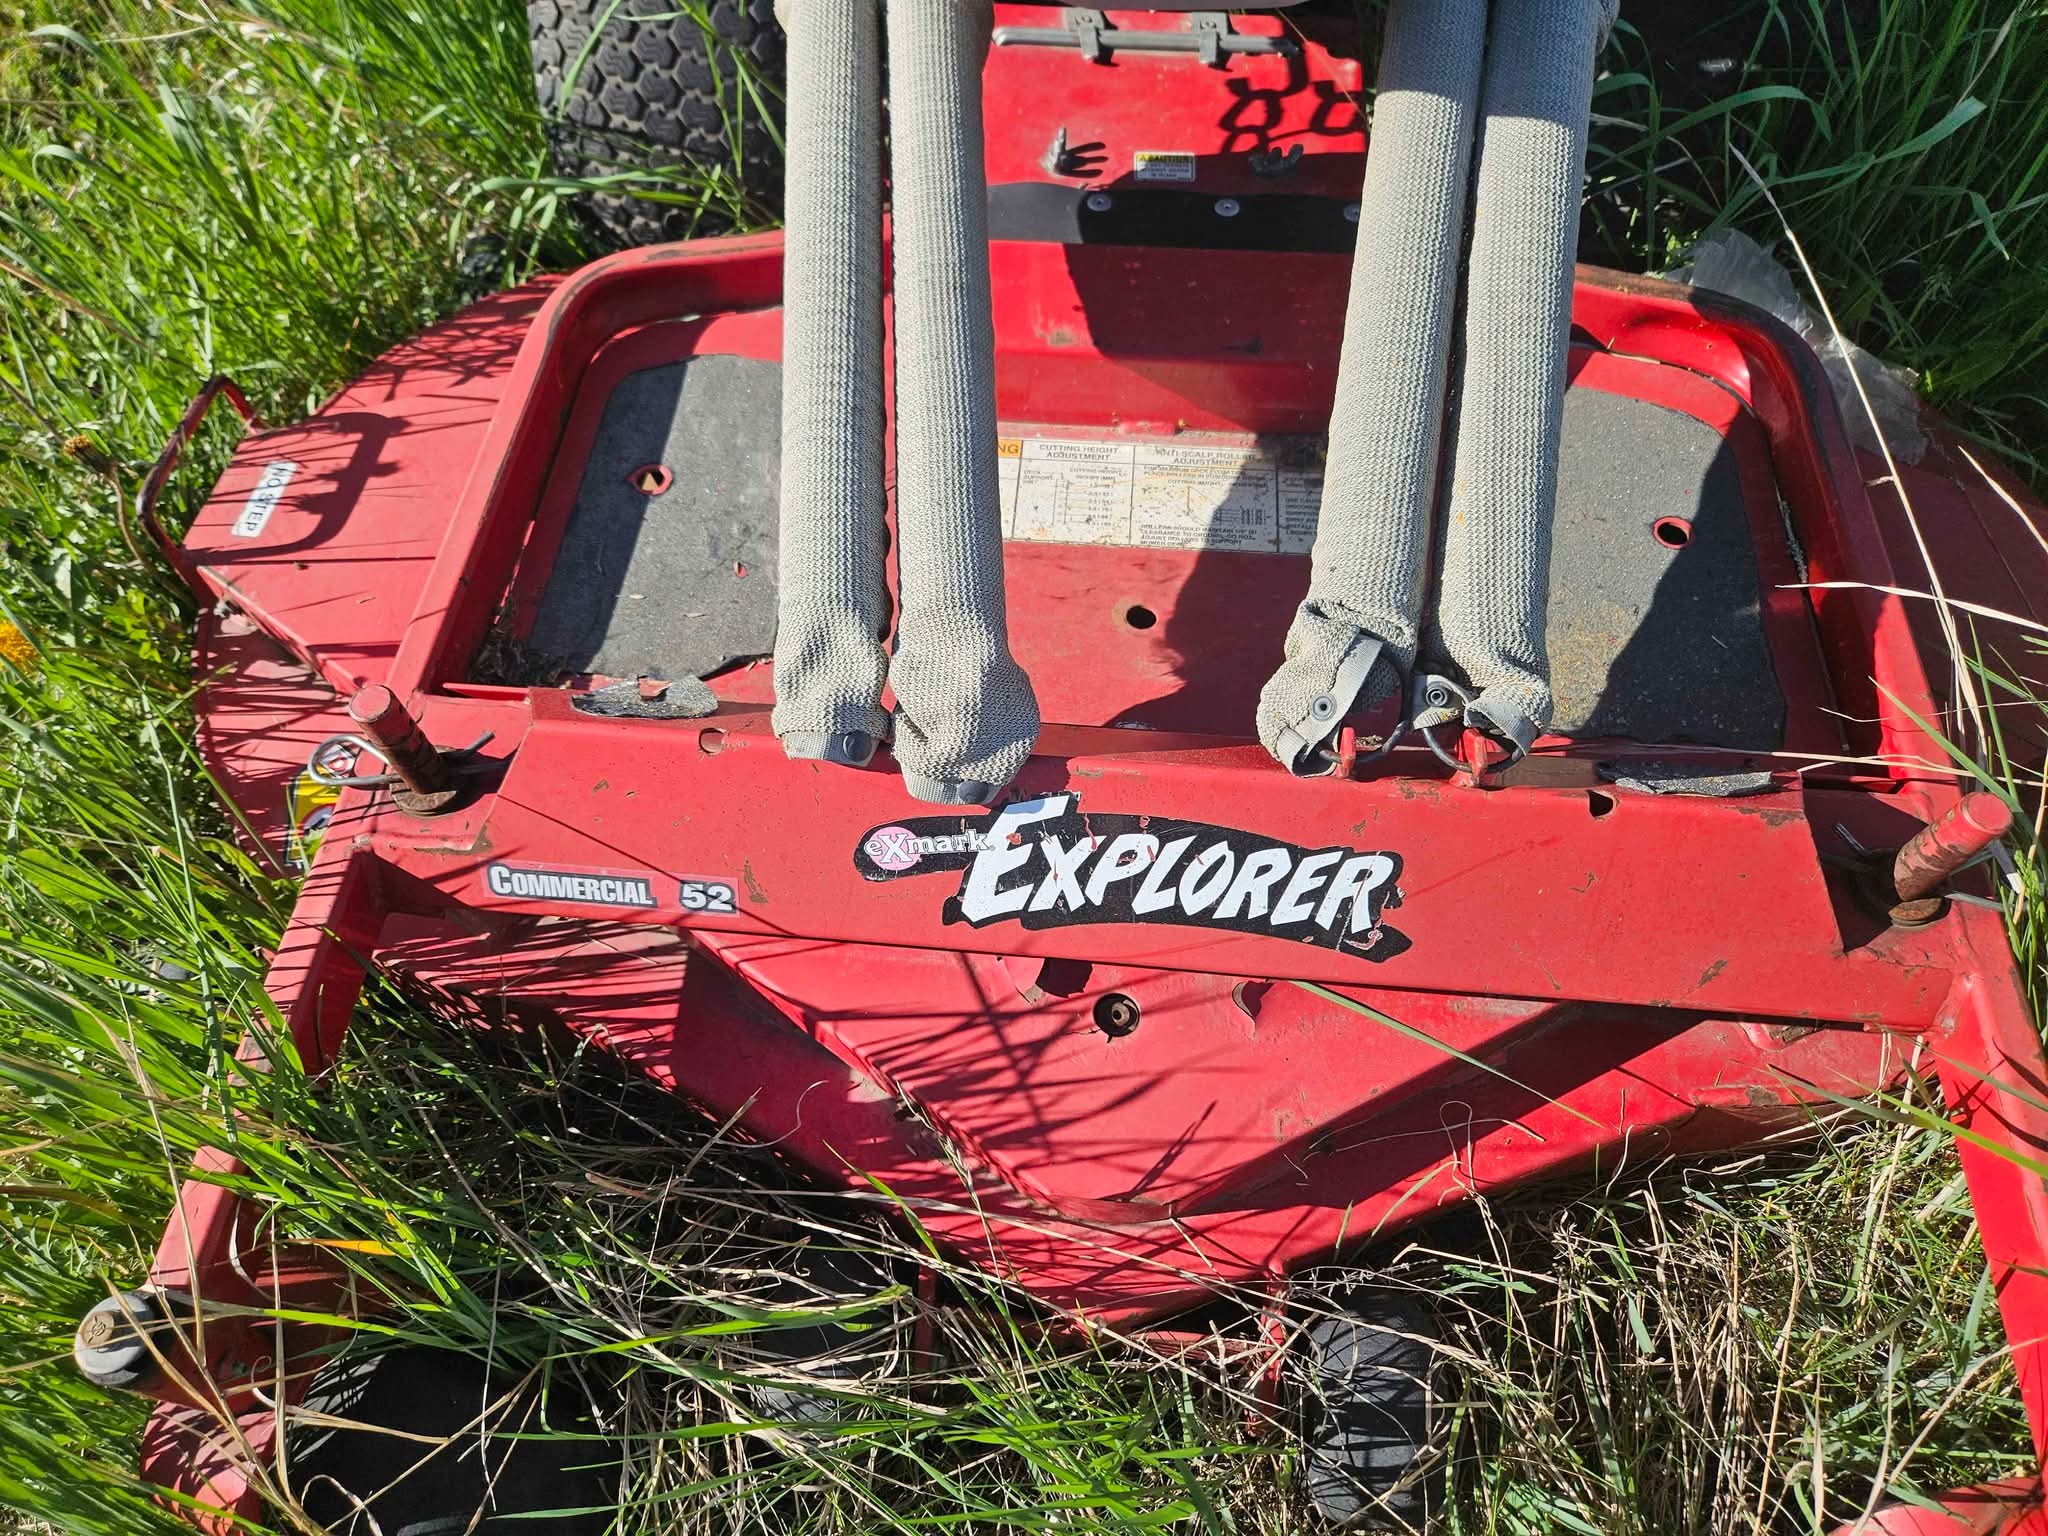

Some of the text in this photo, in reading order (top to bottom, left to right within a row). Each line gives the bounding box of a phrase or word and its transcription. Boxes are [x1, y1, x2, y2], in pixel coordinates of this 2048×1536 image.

[1039, 444, 1119, 454] CUTTING HEIGHT
[1155, 449, 1214, 459] ANTI-SCALP
[1046, 451, 1111, 460] ADJUSTMENT
[1172, 458, 1239, 467] ADJUSTMENT
[960, 795, 1395, 933] EXPLORER
[489, 865, 735, 912] COMMERCIAL 52
